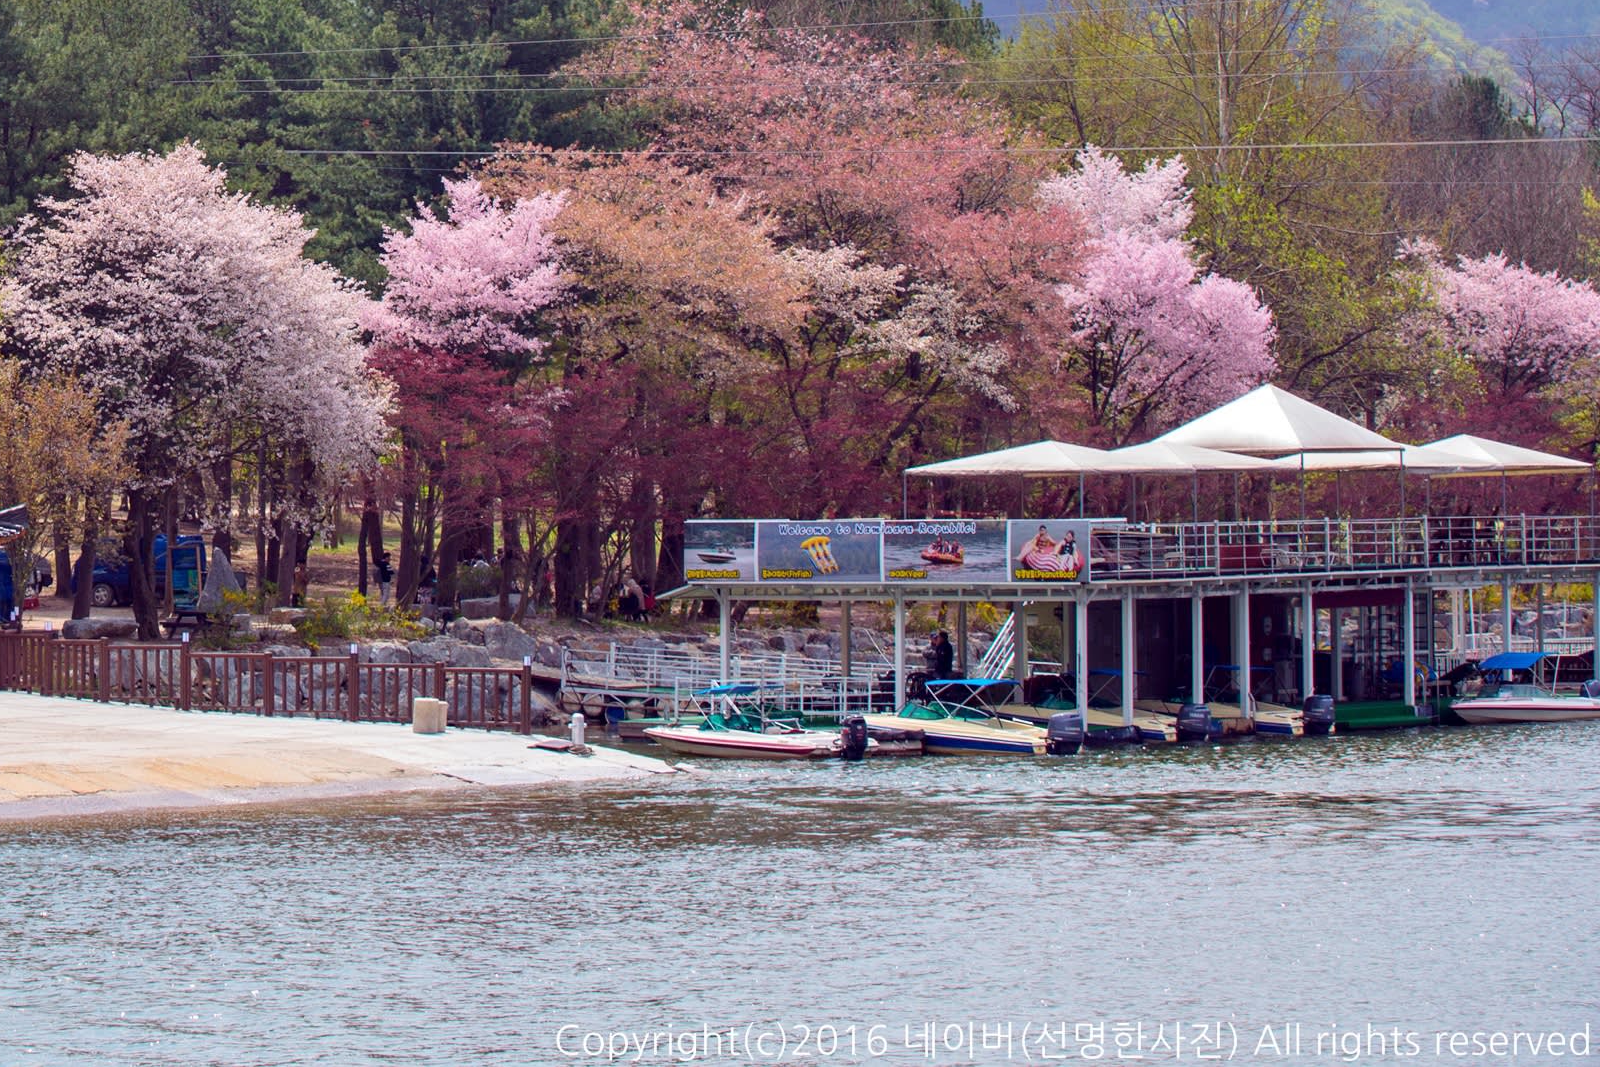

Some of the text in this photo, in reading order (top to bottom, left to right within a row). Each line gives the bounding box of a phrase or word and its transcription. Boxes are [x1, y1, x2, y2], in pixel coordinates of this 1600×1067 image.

[778, 522, 977, 535] Welcome to Naminara Republic!
